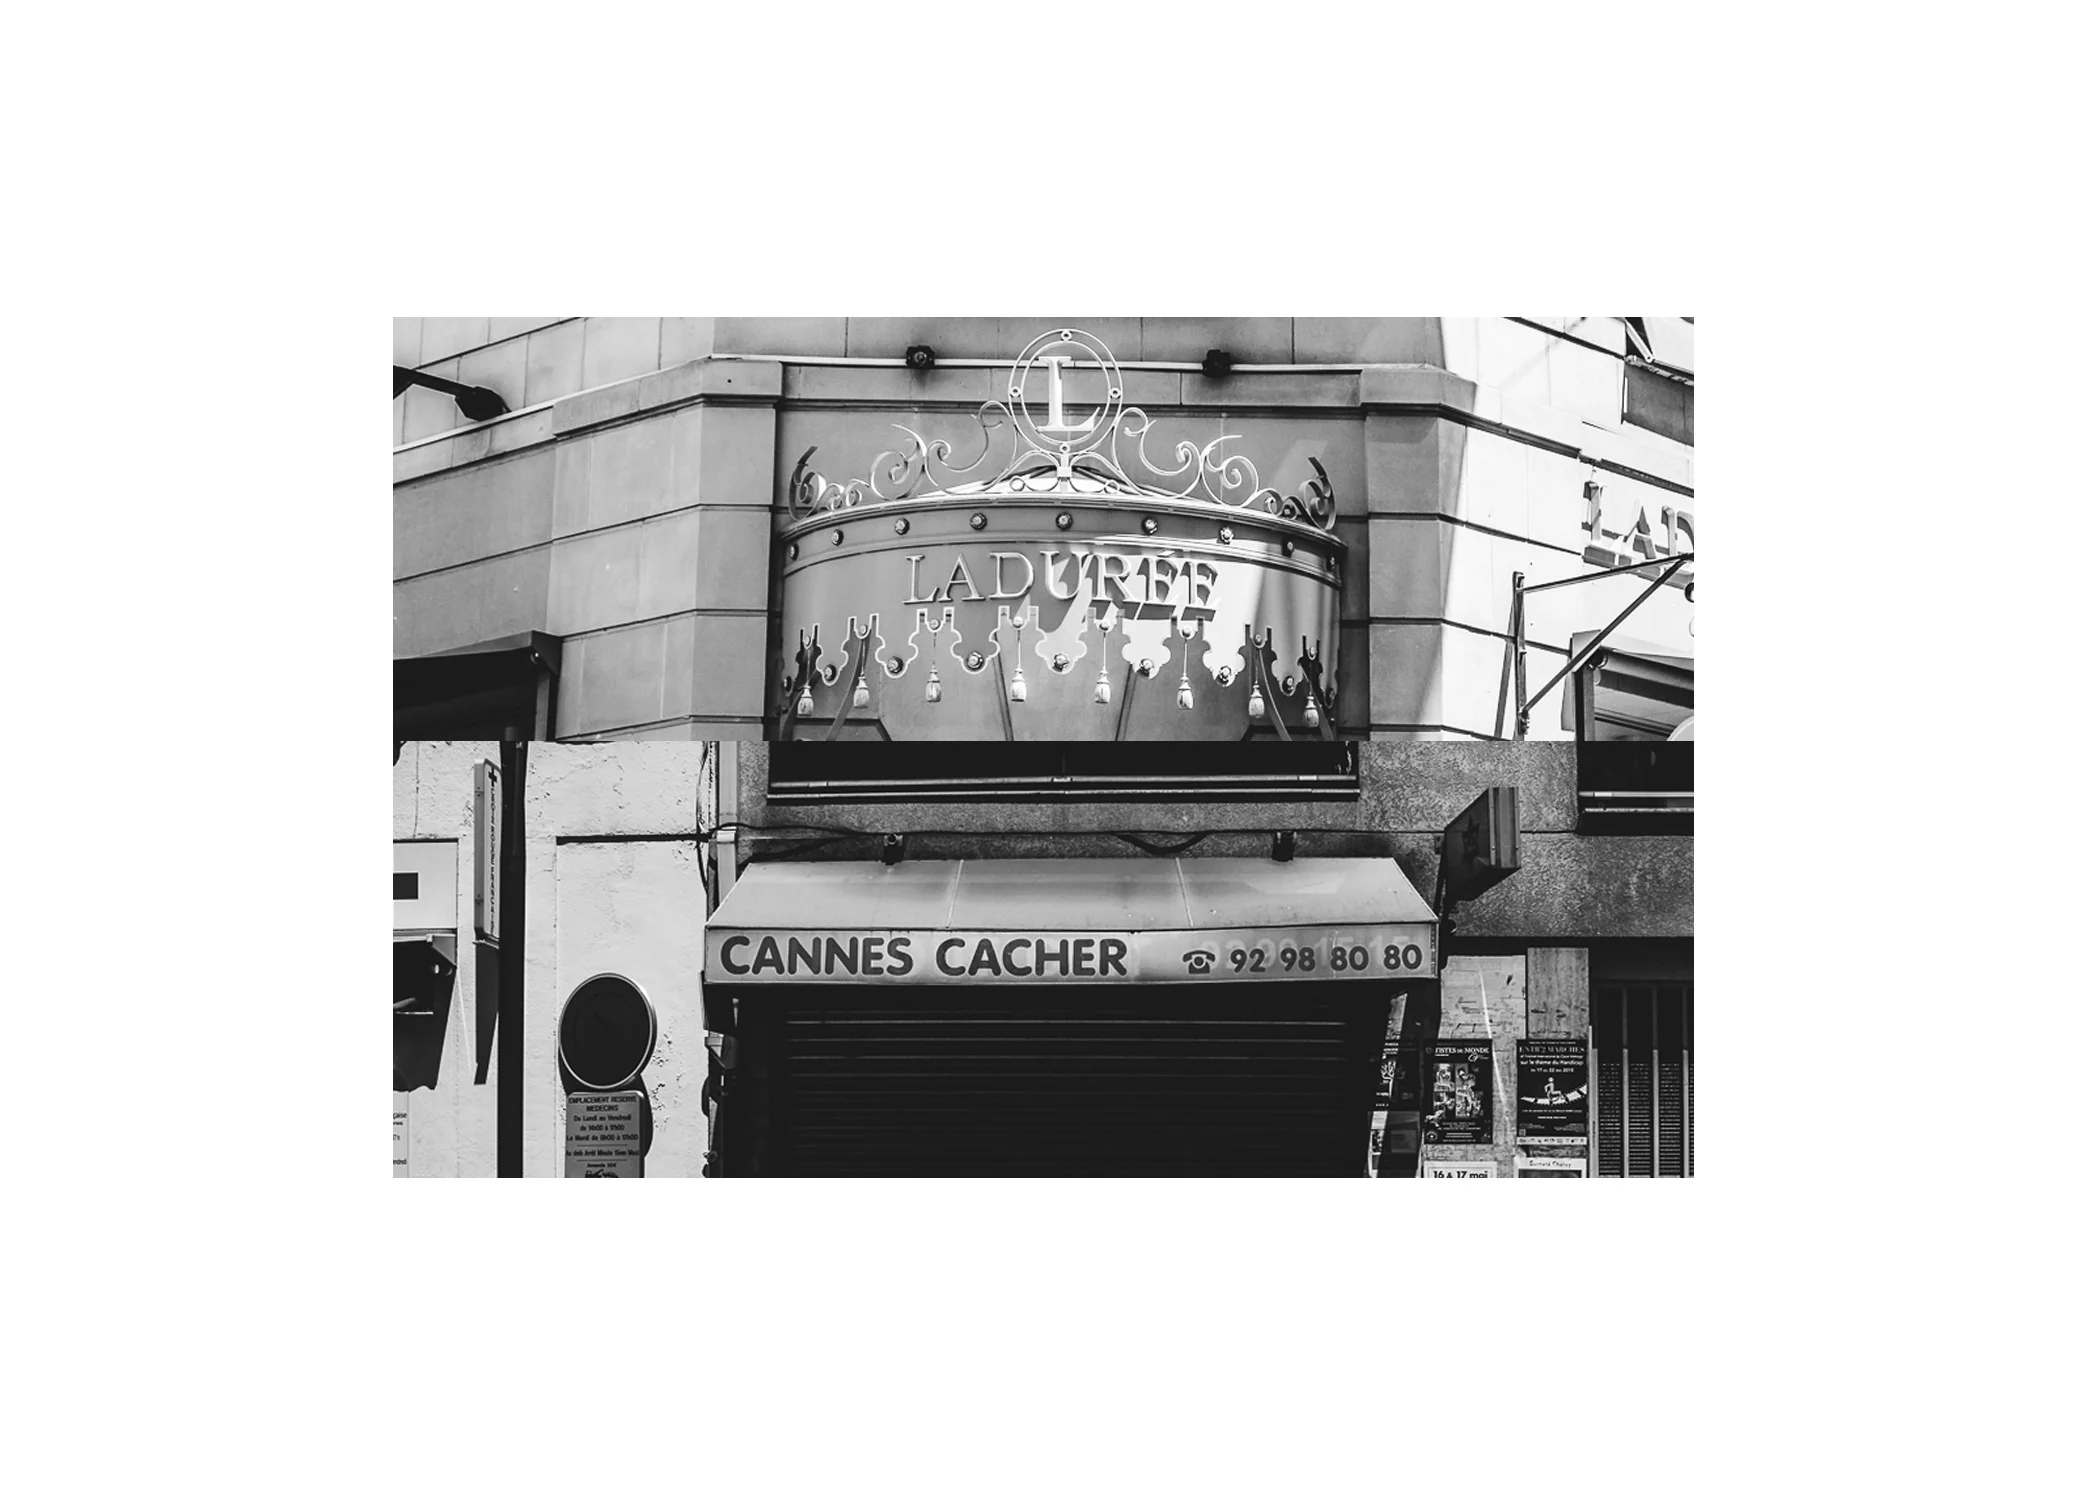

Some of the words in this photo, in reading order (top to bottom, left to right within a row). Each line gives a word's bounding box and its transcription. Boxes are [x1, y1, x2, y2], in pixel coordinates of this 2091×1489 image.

[1038, 356, 1100, 431] L
[902, 549, 1220, 608] LADURÉE
[720, 935, 914, 977] CANNES
[935, 938, 1128, 977] CACHER
[1230, 948, 1266, 974] 92
[1280, 947, 1316, 972] 98
[1330, 946, 1370, 972] 80
[1383, 944, 1423, 970] 80
